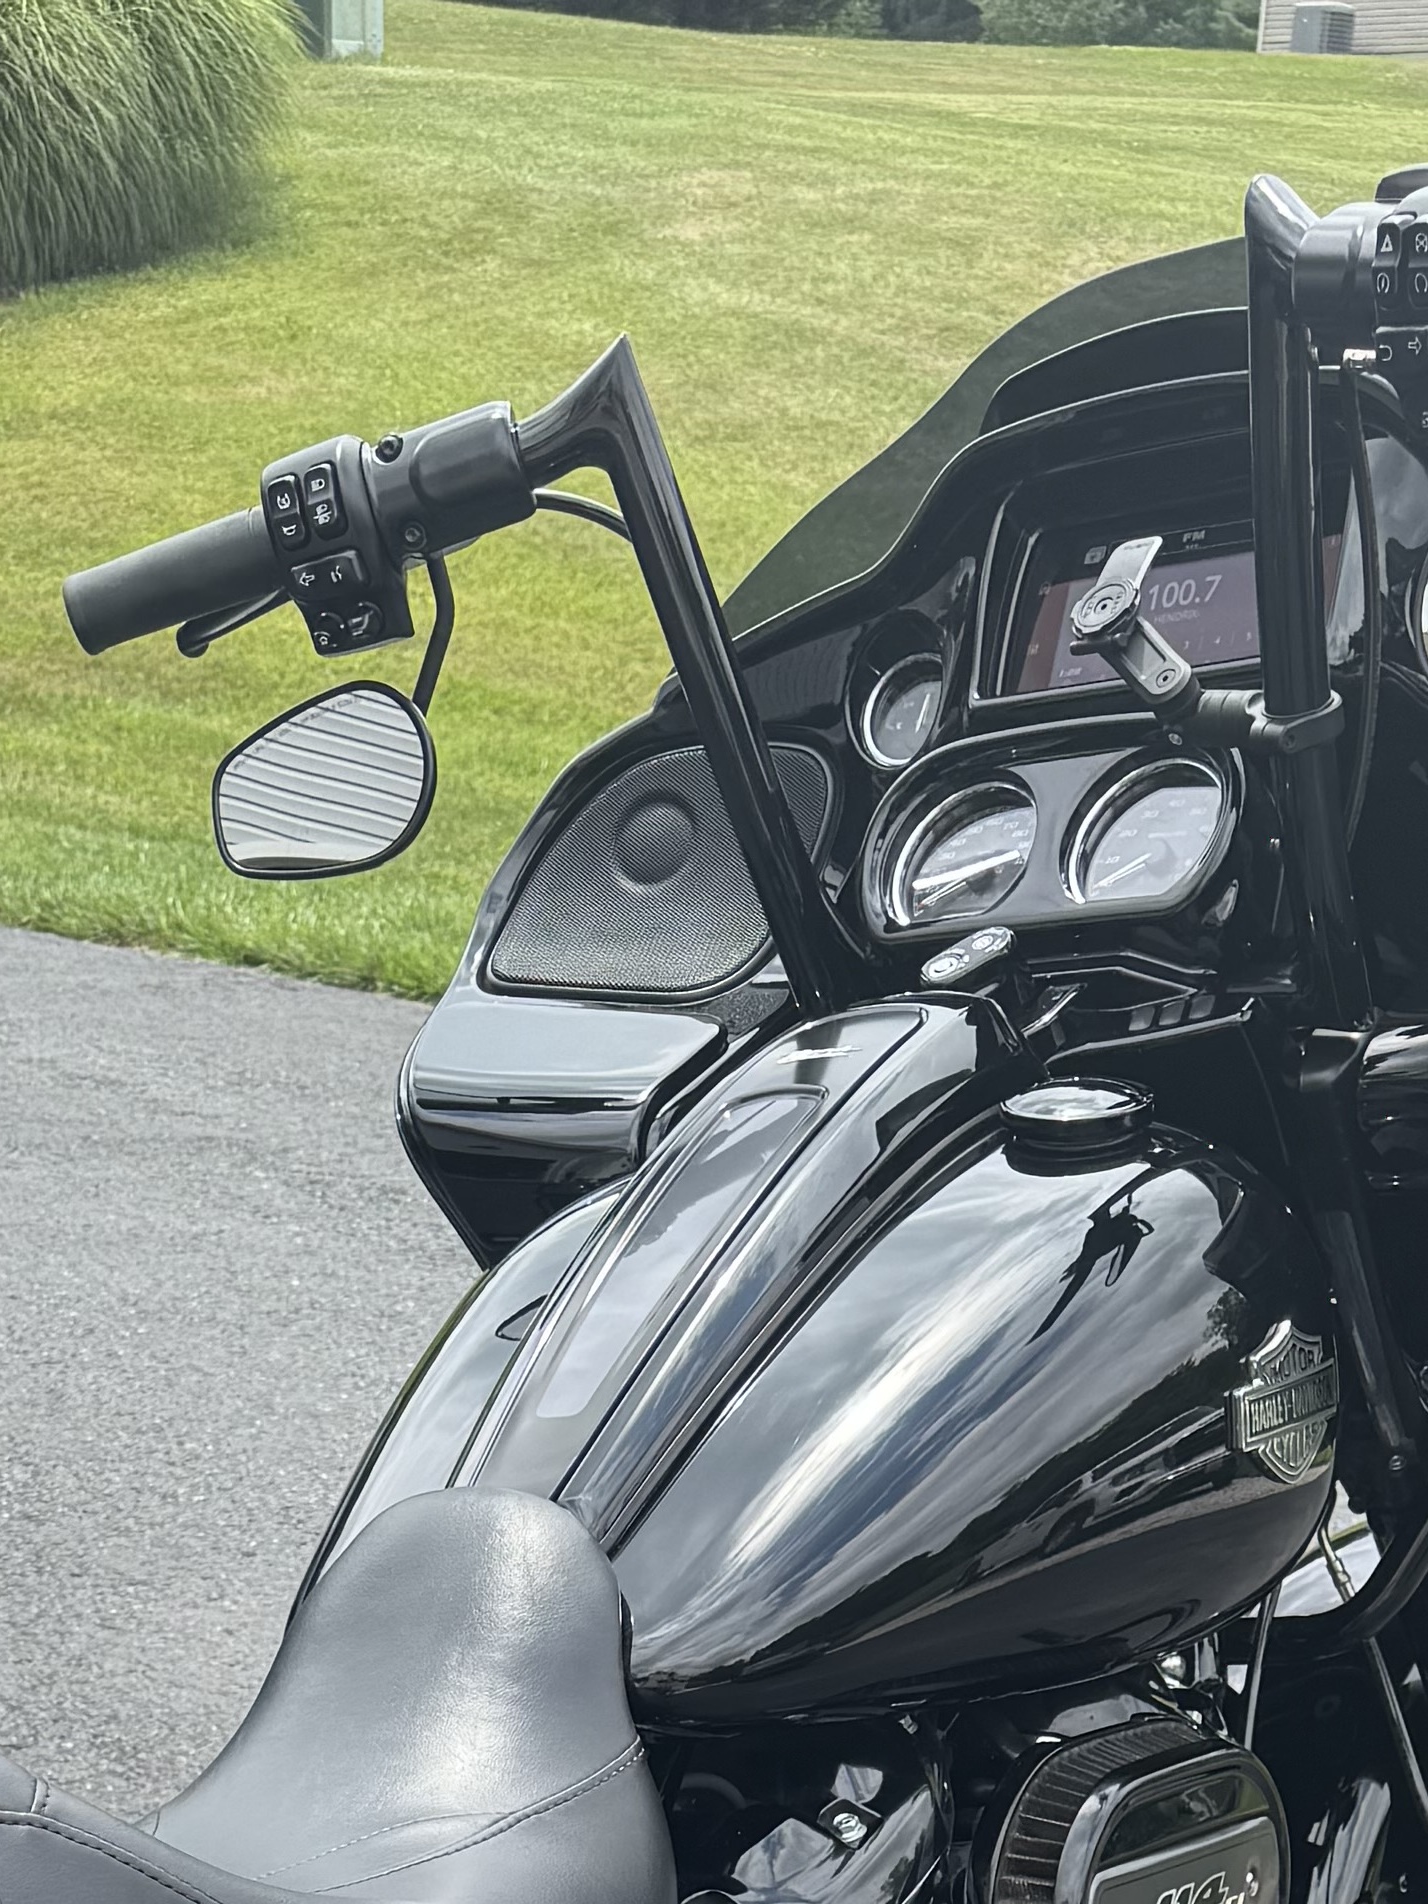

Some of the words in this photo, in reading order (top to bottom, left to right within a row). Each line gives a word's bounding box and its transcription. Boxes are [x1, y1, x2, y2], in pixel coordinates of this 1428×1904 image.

[1182, 529, 1206, 543] FM
[1149, 574, 1223, 611] 100.7
[1269, 1343, 1318, 1385] MOTOR
